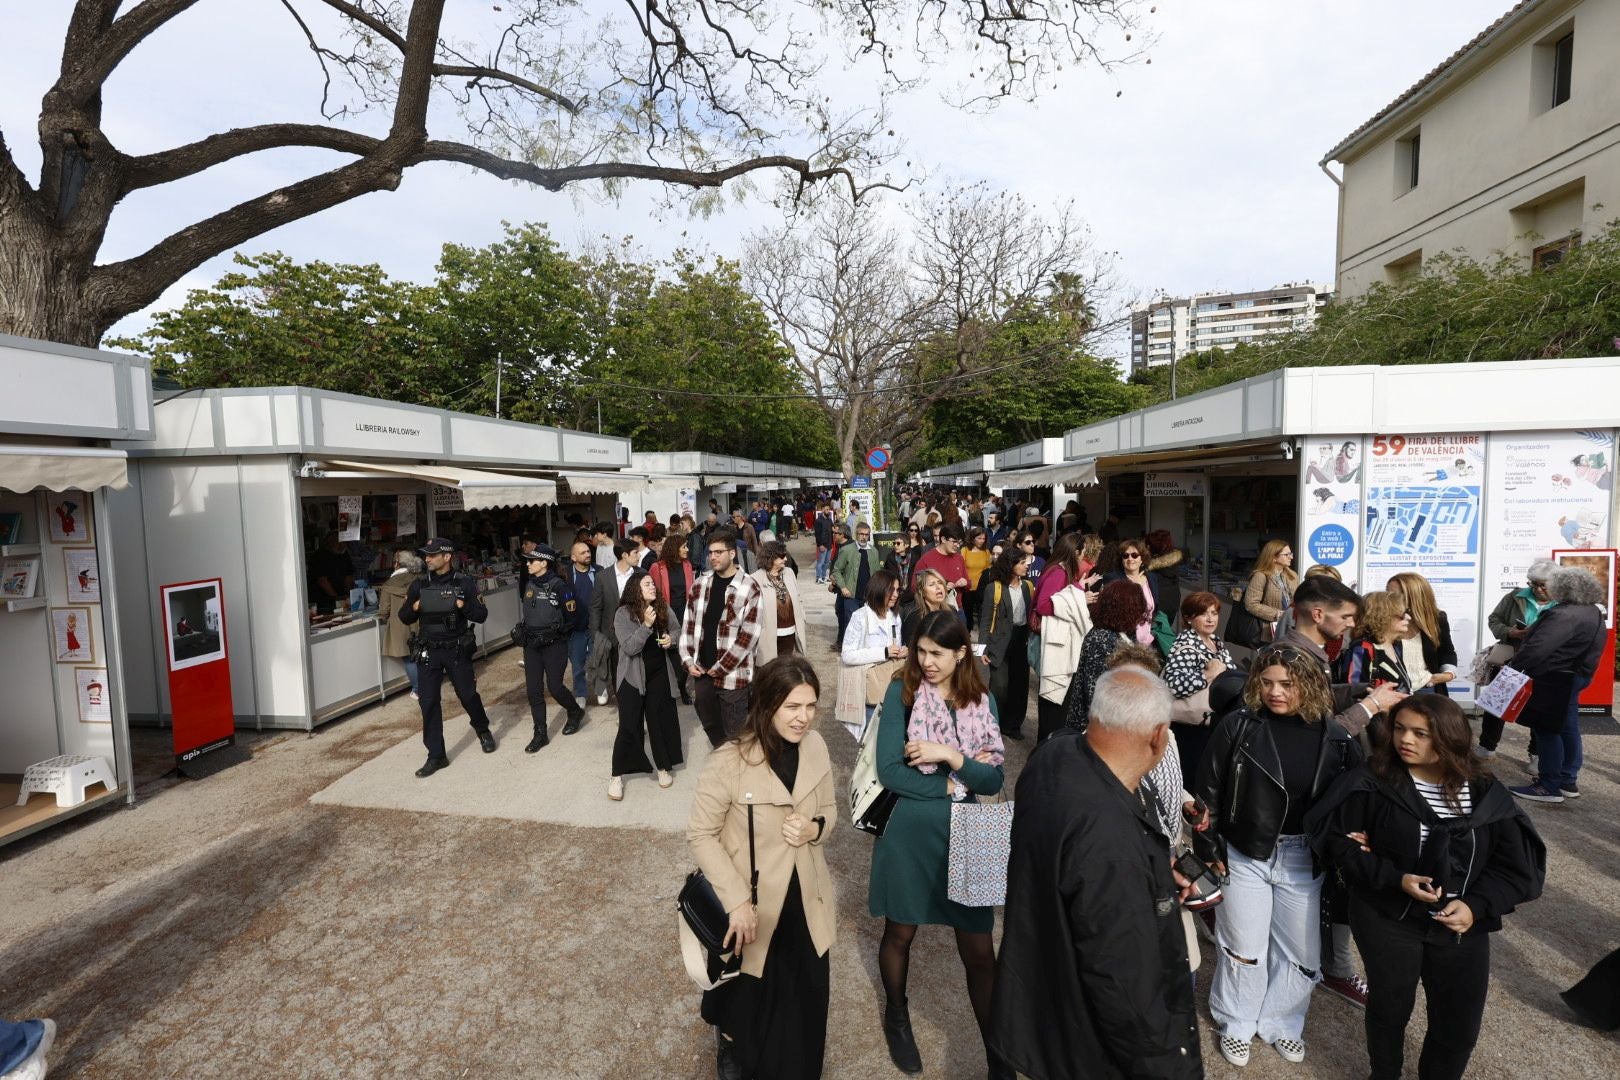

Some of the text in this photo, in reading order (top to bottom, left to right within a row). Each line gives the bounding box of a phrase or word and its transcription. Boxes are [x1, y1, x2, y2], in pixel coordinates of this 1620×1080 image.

[356, 424, 420, 436] LLIBRERIA RAILOWSKY
[1372, 435, 1406, 456] 59
[1408, 436, 1480, 446] FIRA DEL LLIBRE
[1408, 448, 1419, 456] DE
